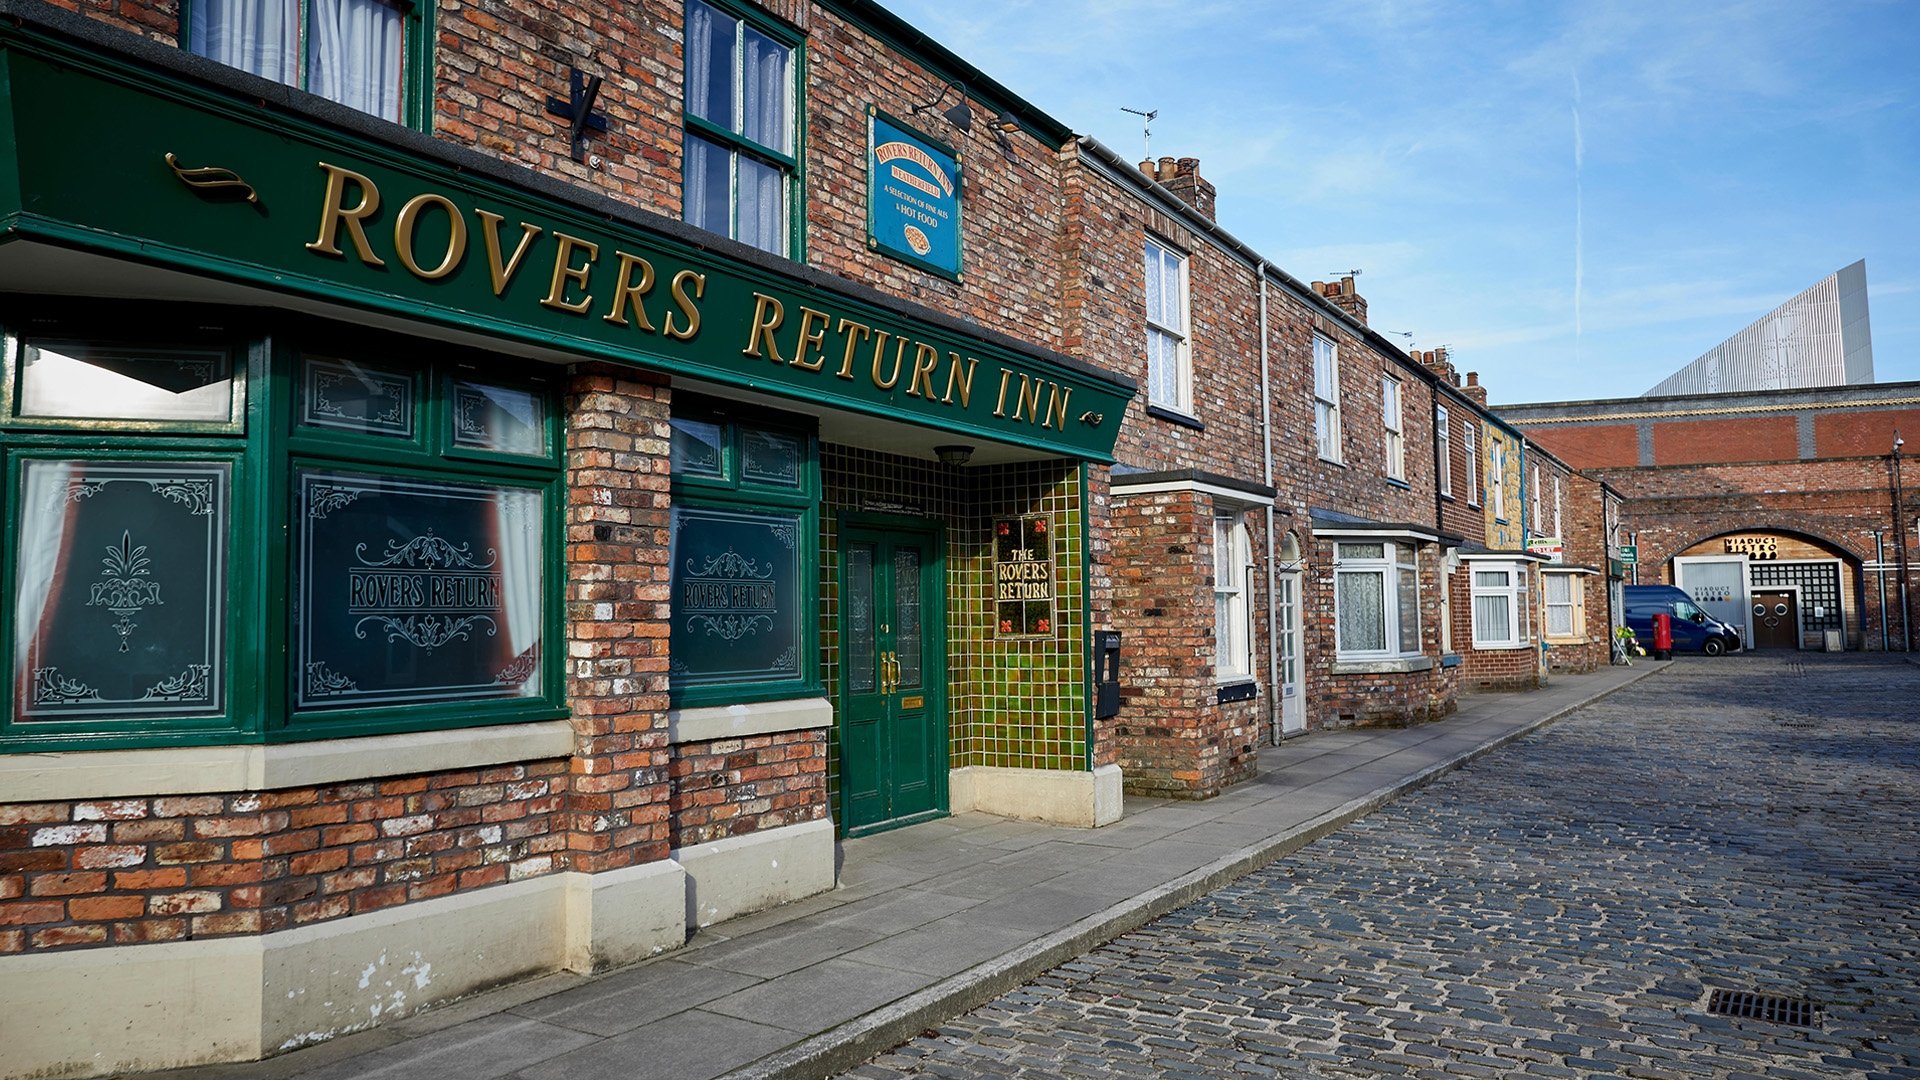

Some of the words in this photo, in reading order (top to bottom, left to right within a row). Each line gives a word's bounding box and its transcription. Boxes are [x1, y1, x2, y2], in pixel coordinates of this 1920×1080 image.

[877, 144, 908, 163] ROVERS
[908, 146, 938, 176] RETURN
[938, 171, 951, 194] INN
[893, 167, 939, 197] WEATHERFIELD
[889, 186, 917, 204] SELECTION
[917, 199, 925, 208] OF
[925, 203, 937, 214] FINE
[937, 208, 949, 219] ALES
[900, 203, 916, 218] HOT
[917, 211, 938, 228] FOOD
[305, 161, 705, 339] ROVERS
[742, 292, 979, 408] RETURN
[993, 368, 1073, 431] INN
[1727, 537, 1776, 545] VIADUCT
[1727, 544, 1777, 552] BISTRO
[1011, 548, 1035, 561] THE
[999, 562, 1049, 580] ROVERS
[350, 574, 424, 607] ROVERS
[430, 575, 500, 608] RETURN
[683, 582, 729, 608] ROVERS
[731, 583, 776, 609] RETURN
[999, 581, 1049, 599] RETURN
